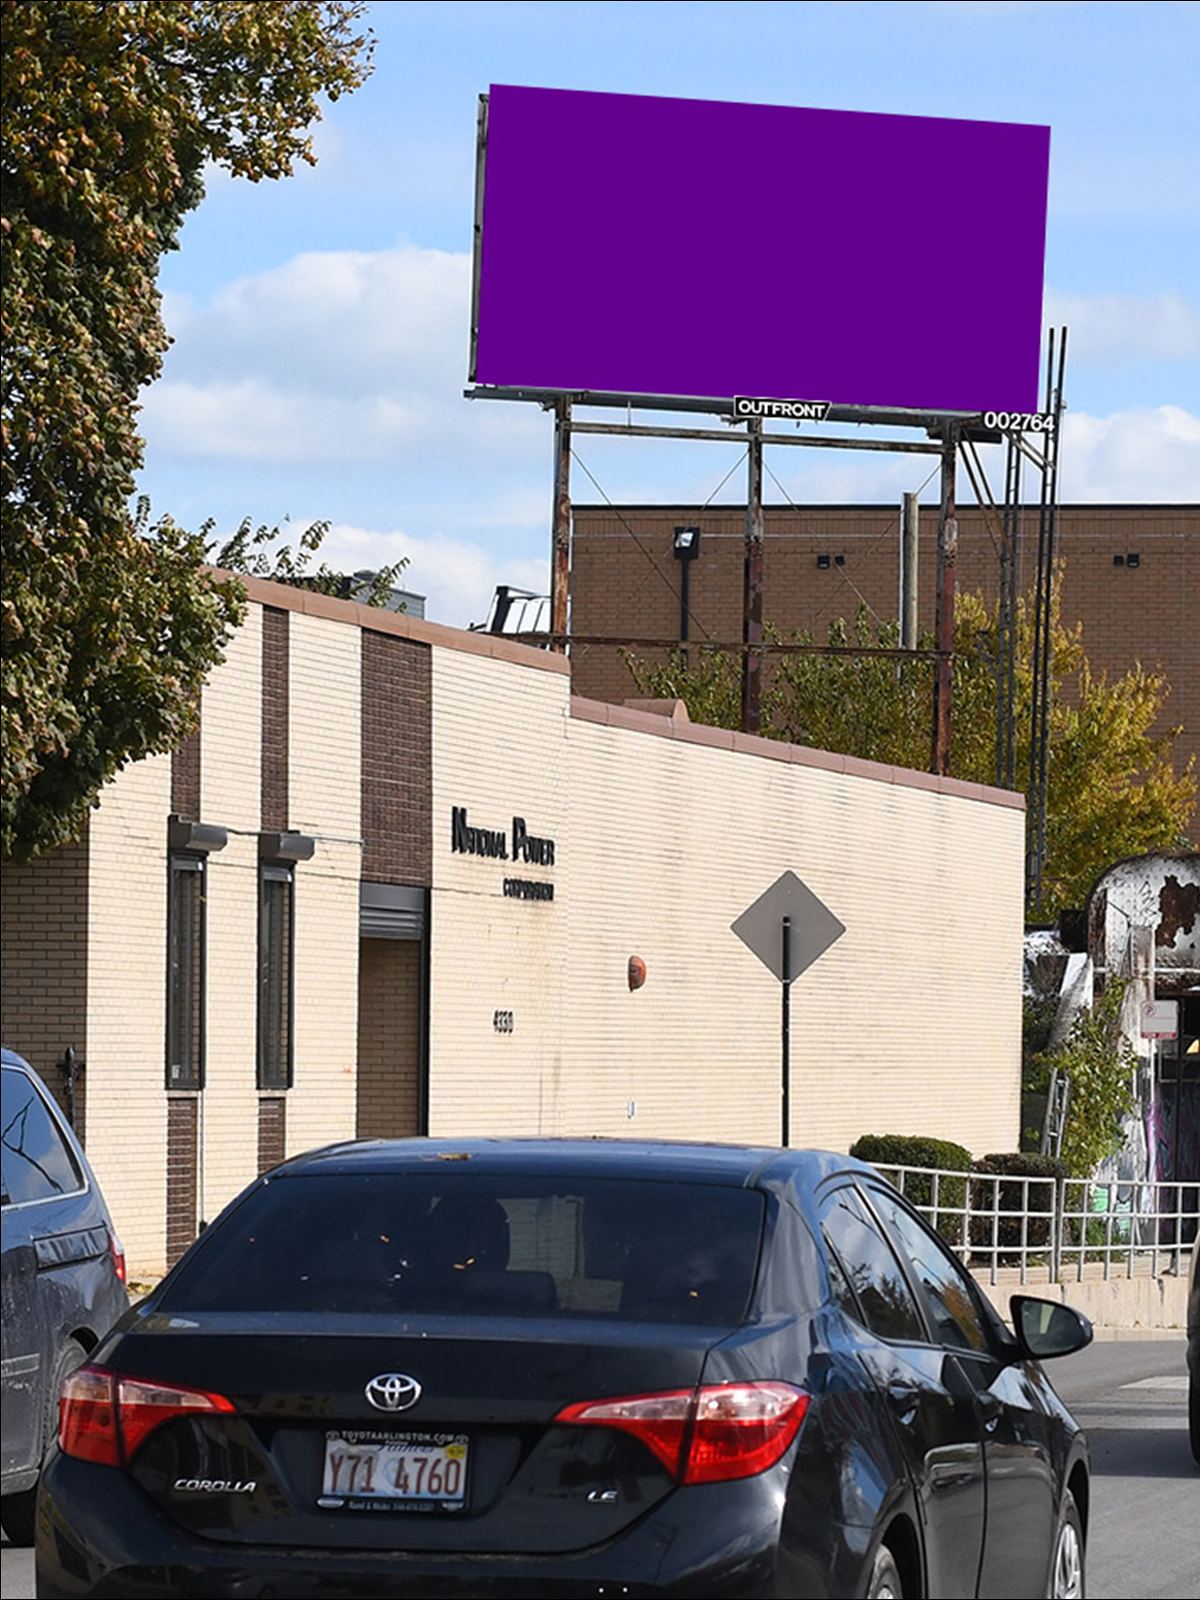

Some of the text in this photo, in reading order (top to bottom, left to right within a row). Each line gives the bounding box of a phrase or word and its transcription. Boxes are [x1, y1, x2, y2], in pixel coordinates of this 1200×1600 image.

[738, 401, 825, 418] OUTFRONT
[983, 411, 1055, 431] 002764
[342, 1430, 455, 1442] TOYOTAARLINGTON.COM
[330, 1454, 461, 1495] Y71 4760
[174, 1479, 257, 1493] COROLLA
[588, 1490, 618, 1503] LE
